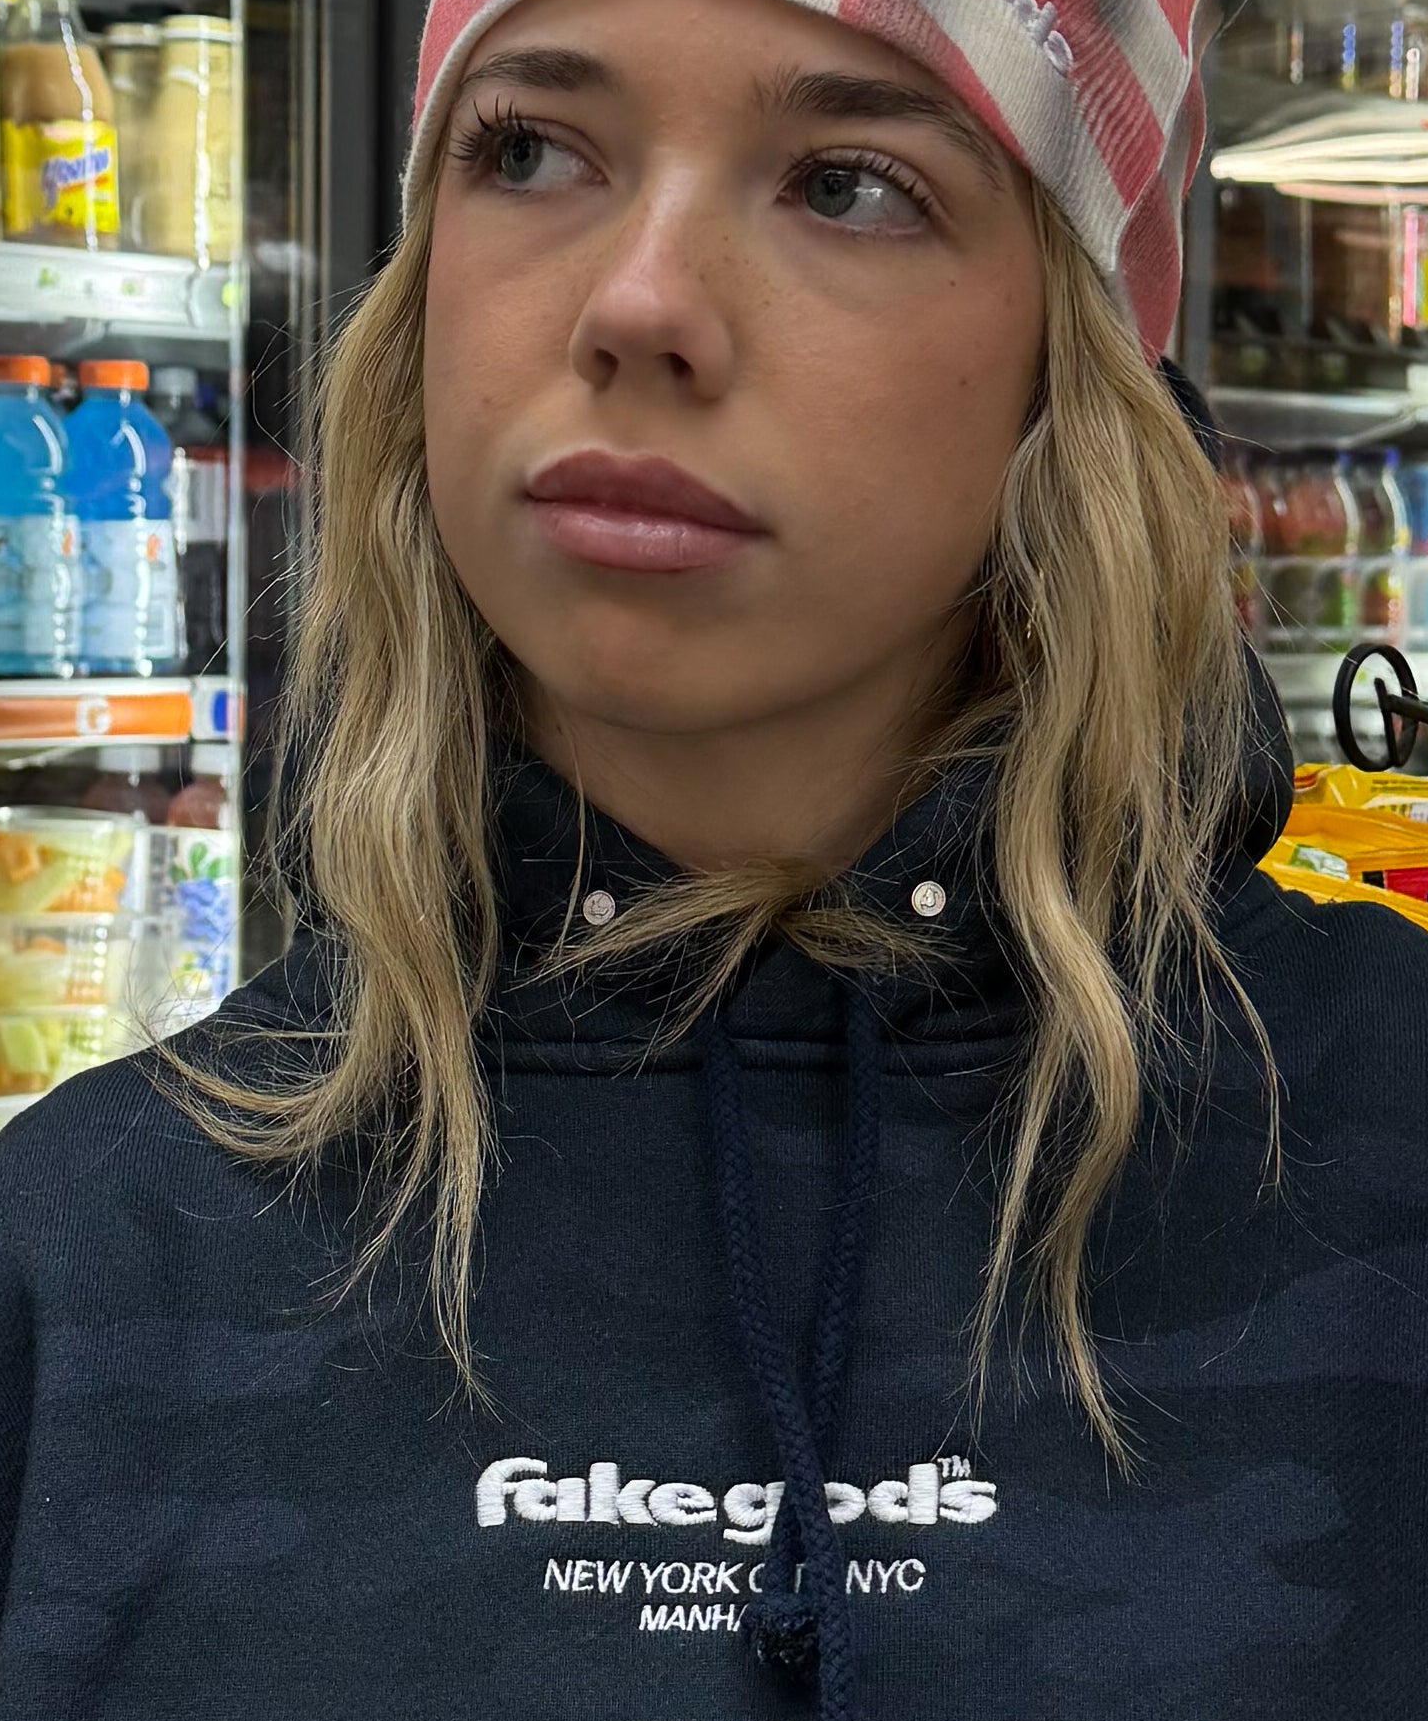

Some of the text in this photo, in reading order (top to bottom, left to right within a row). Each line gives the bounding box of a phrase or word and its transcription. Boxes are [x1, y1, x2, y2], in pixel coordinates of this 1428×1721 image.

[477, 1457, 997, 1546] fakegods
[542, 1558, 634, 1595] NEW
[638, 1560, 742, 1596] YORK
[844, 1558, 926, 1595] NYC
